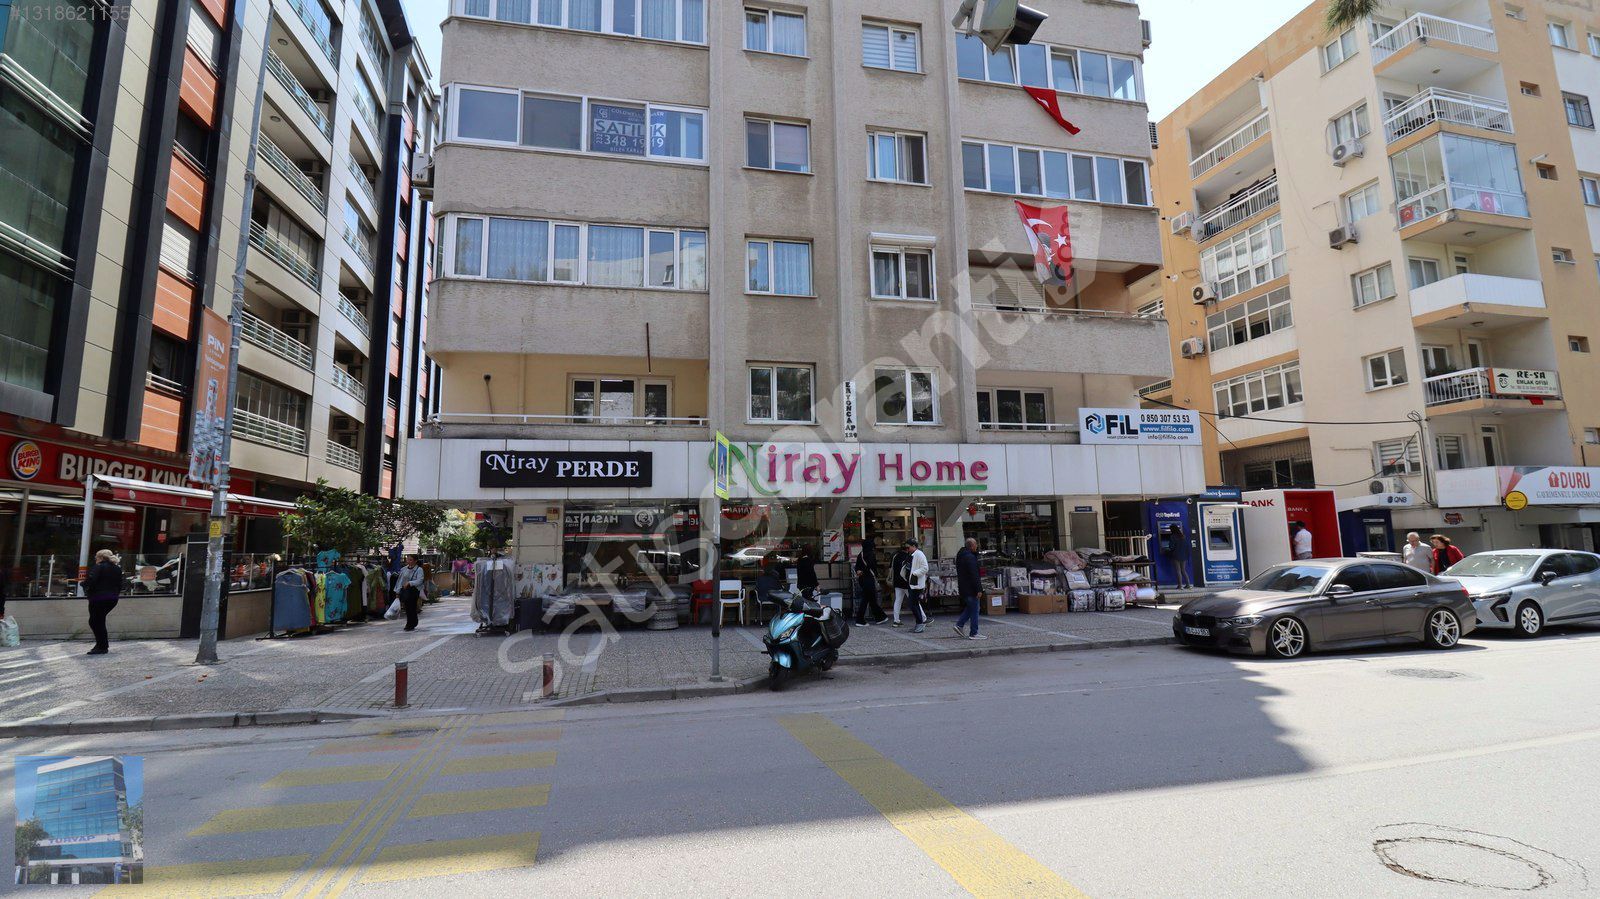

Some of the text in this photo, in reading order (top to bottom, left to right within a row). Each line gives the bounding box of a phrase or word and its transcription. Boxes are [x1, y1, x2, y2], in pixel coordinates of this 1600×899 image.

[595, 120, 664, 137] SATILK
[604, 134, 627, 147] 348
[1516, 370, 1546, 379] RE-SA
[1141, 414, 1190, 423] 0 850 307 53 53
[18, 456, 40, 469] KING
[485, 453, 640, 478] Niray PERDE
[708, 443, 989, 496] Niray Home
[1560, 471, 1590, 489] DURU
